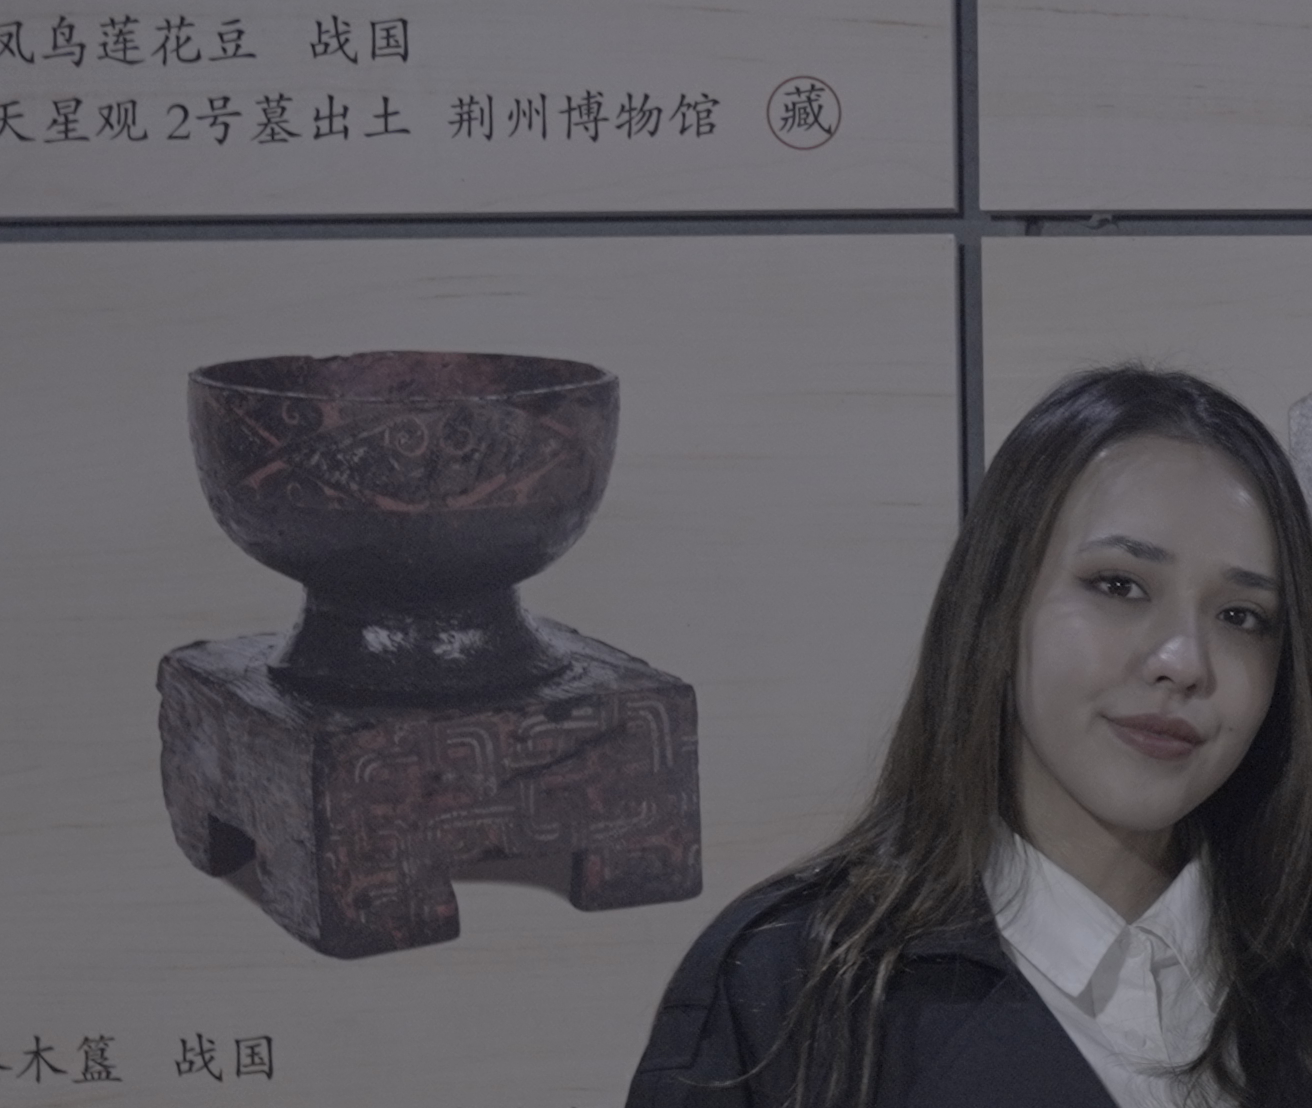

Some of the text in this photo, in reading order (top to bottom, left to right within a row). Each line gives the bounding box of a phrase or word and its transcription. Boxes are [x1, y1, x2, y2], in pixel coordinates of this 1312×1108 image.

[0, 14, 411, 68] 凤鸟莲花豆 战国
[447, 89, 721, 143] 荆州博物馆
[779, 84, 833, 137] 藏
[0, 1032, 274, 1084] 木簋 战国
